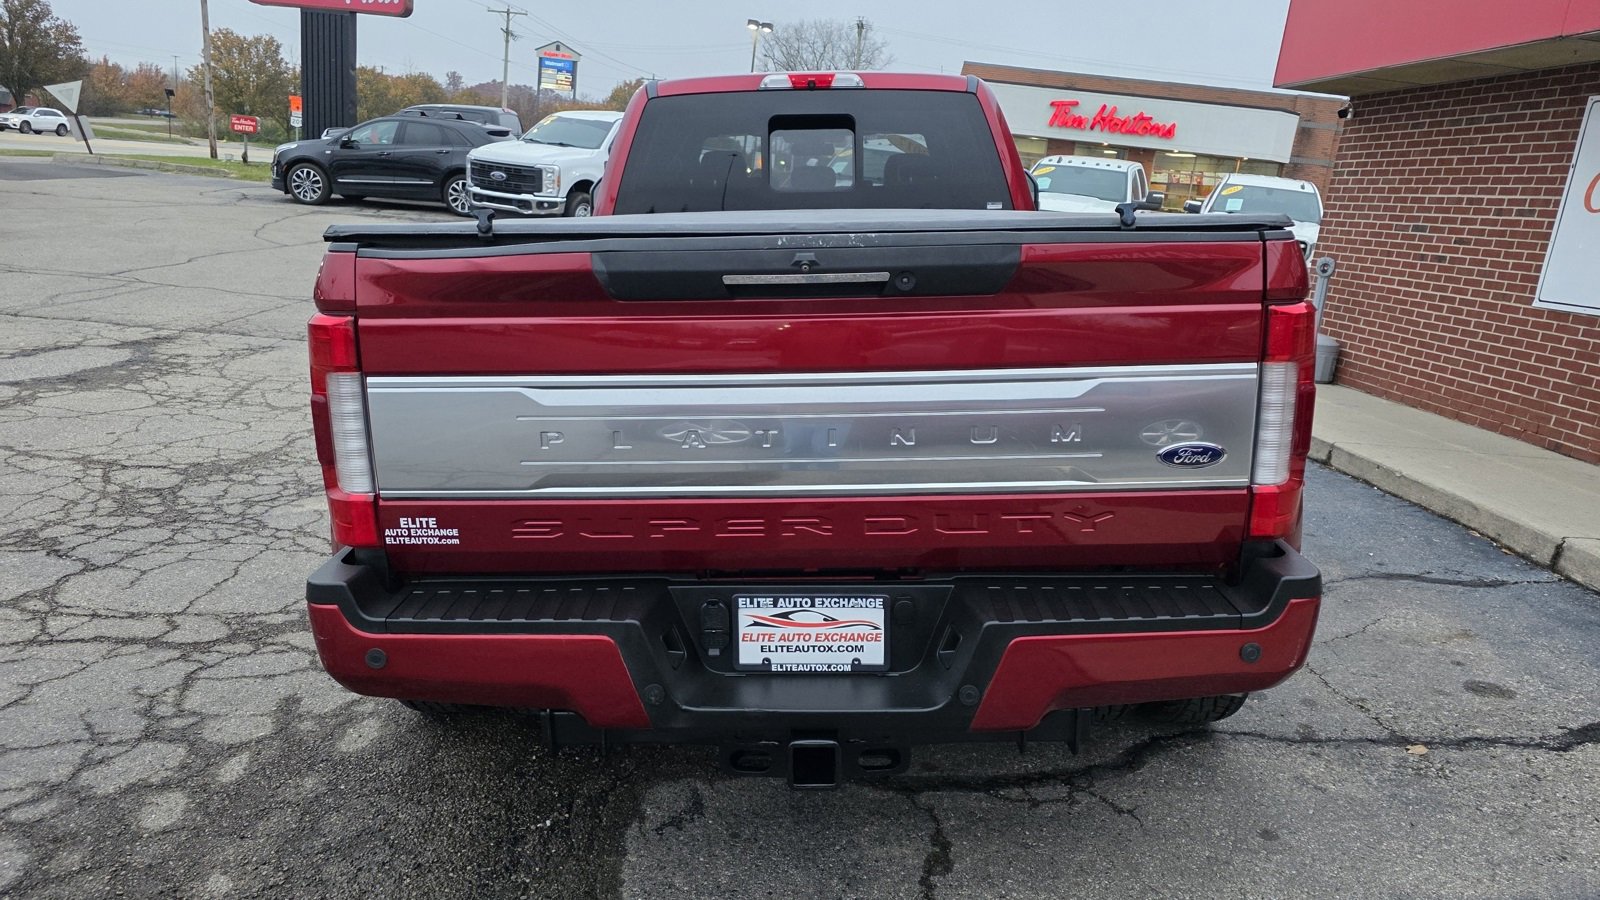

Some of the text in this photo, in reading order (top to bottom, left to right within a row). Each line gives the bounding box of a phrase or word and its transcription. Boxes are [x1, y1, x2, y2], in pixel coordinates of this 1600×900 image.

[1048, 100, 1177, 139] Tim Hortons
[540, 423, 1082, 450] PLATINUM
[1173, 447, 1212, 464] Ford
[399, 517, 438, 528] ELITE
[512, 511, 1116, 539] SUPER DUTY
[384, 528, 459, 537] AUTO EXCHANGE
[738, 597, 884, 608] ELITE AUTO EXCHANGE
[741, 632, 883, 643] ELITE AUTO EXCHANGE
[760, 644, 865, 653] ELITEAUTOX.COM
[771, 664, 852, 672] ELITEAUTOX.COM
